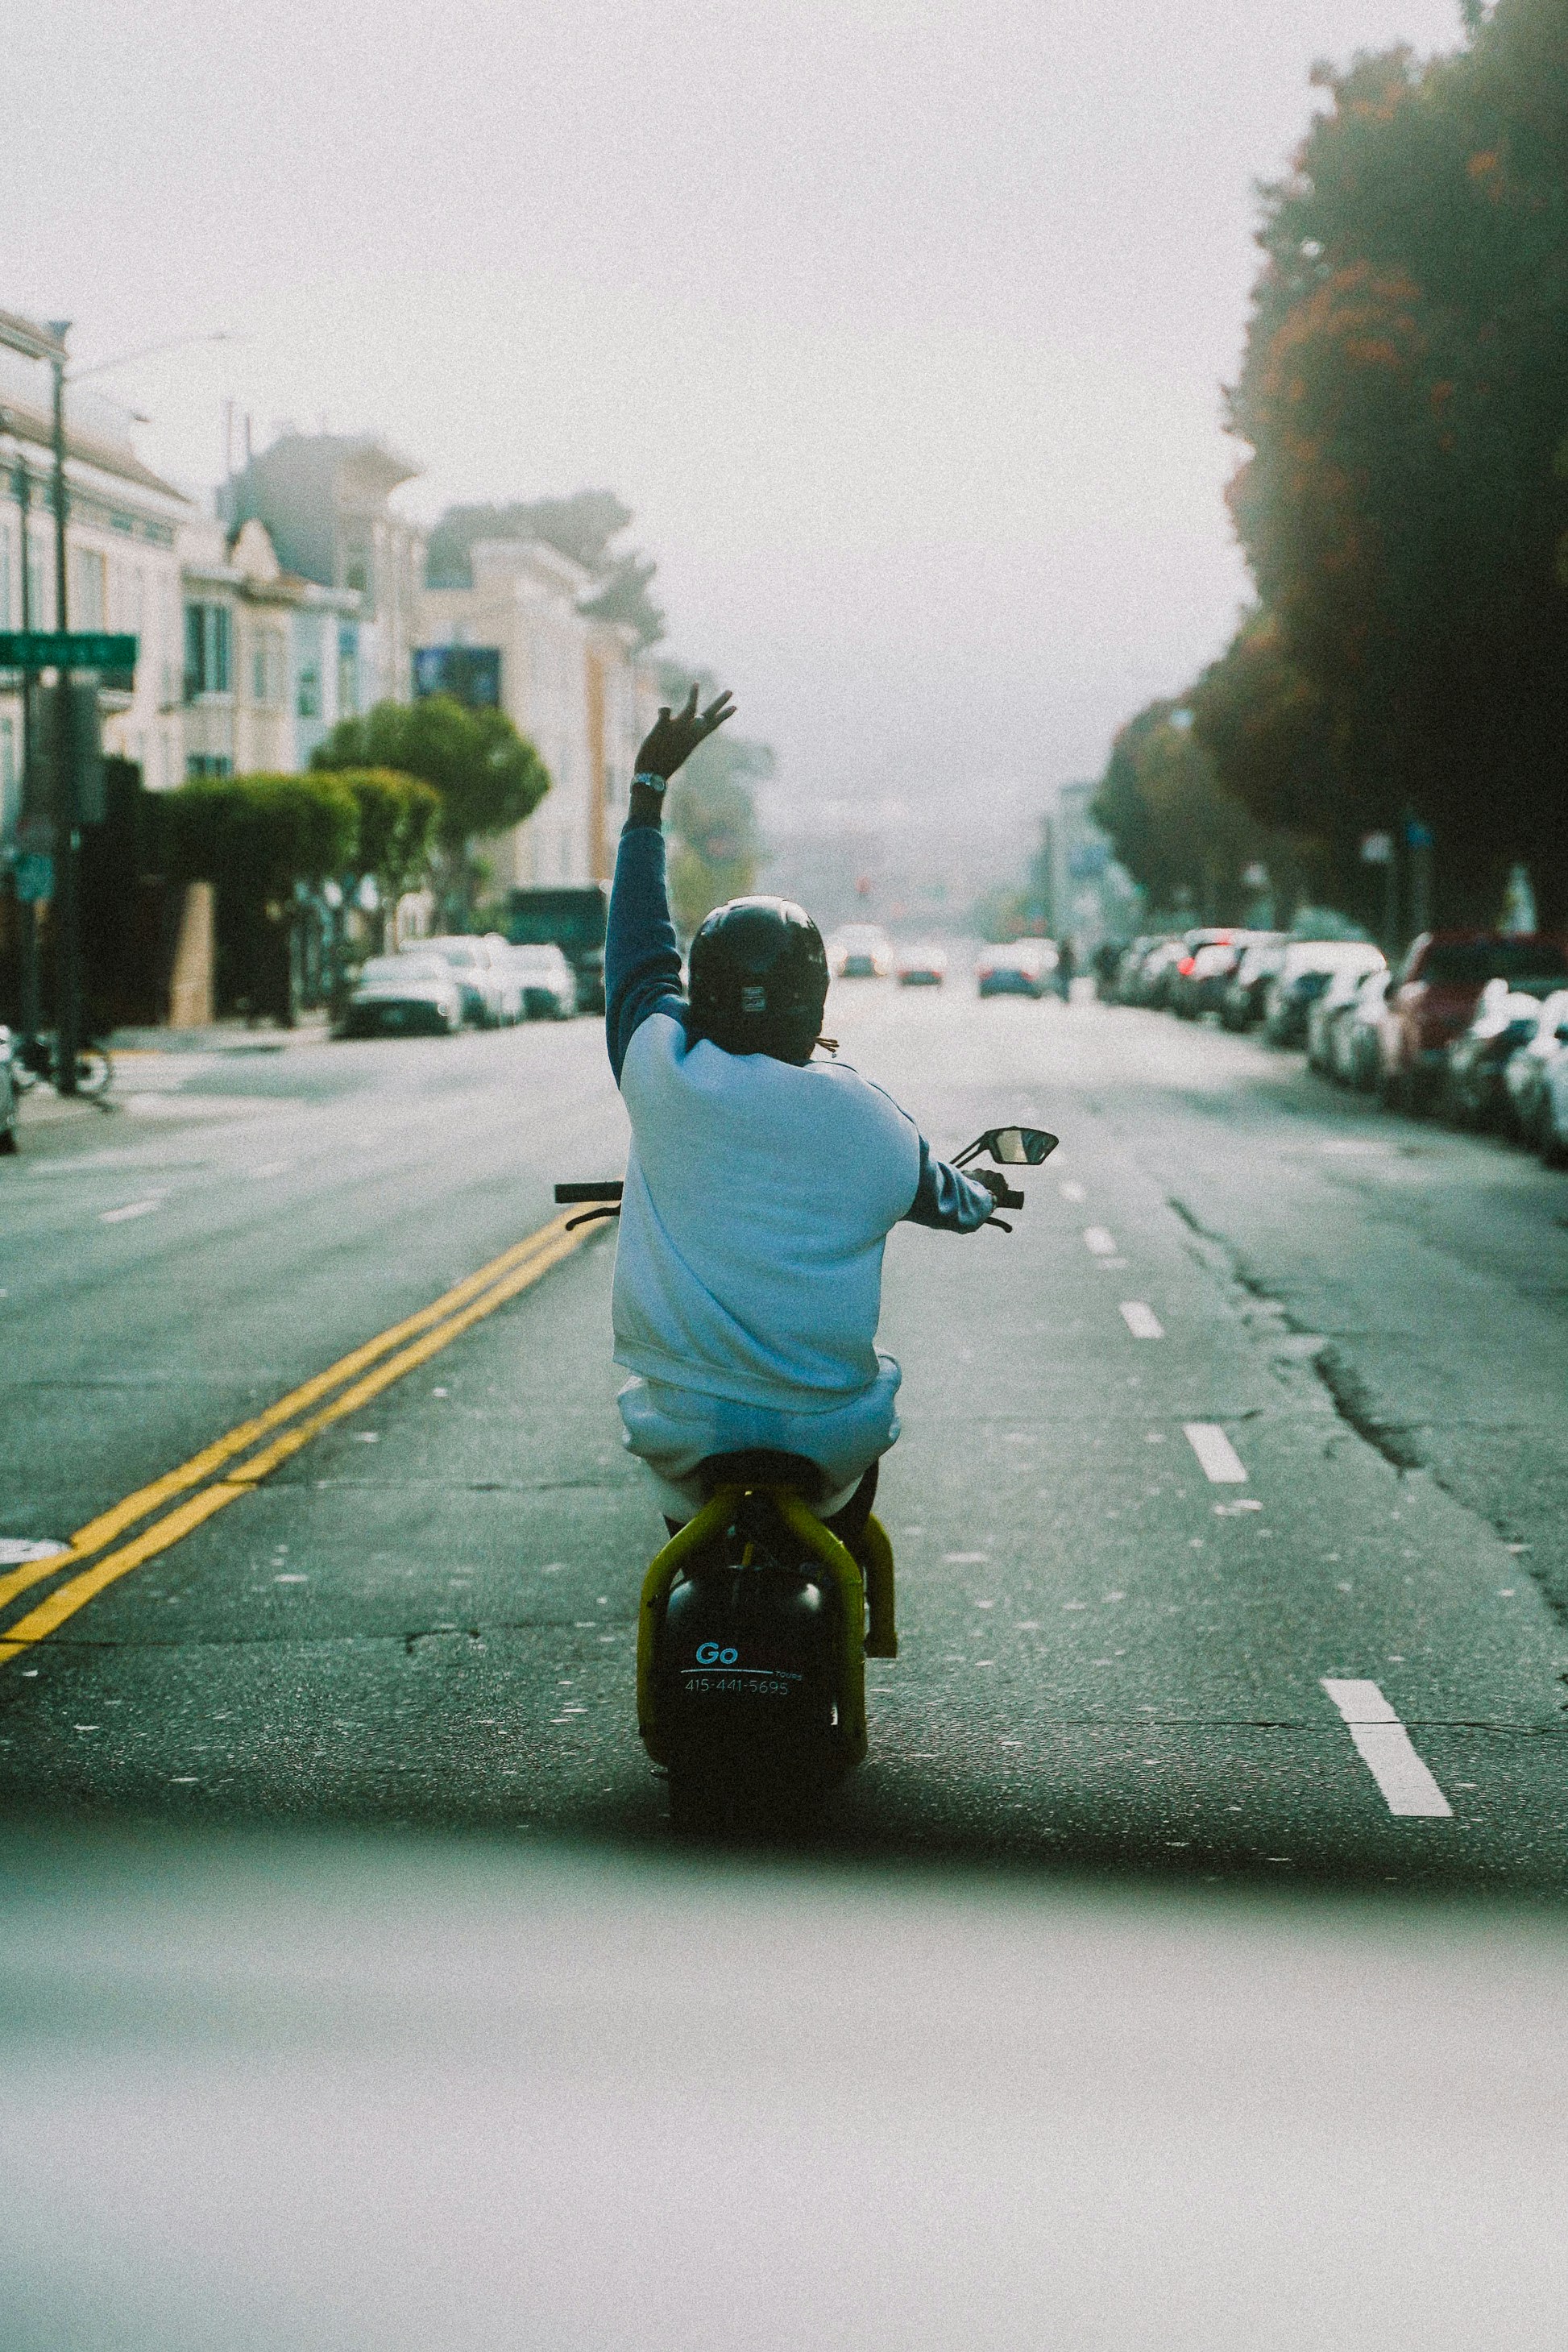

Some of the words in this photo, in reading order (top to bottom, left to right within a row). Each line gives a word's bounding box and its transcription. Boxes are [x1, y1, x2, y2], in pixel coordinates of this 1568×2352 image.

[695, 1641, 738, 1665] Go
[775, 1670, 803, 1681] TOURS
[685, 1678, 789, 1695] 415-441-5695
